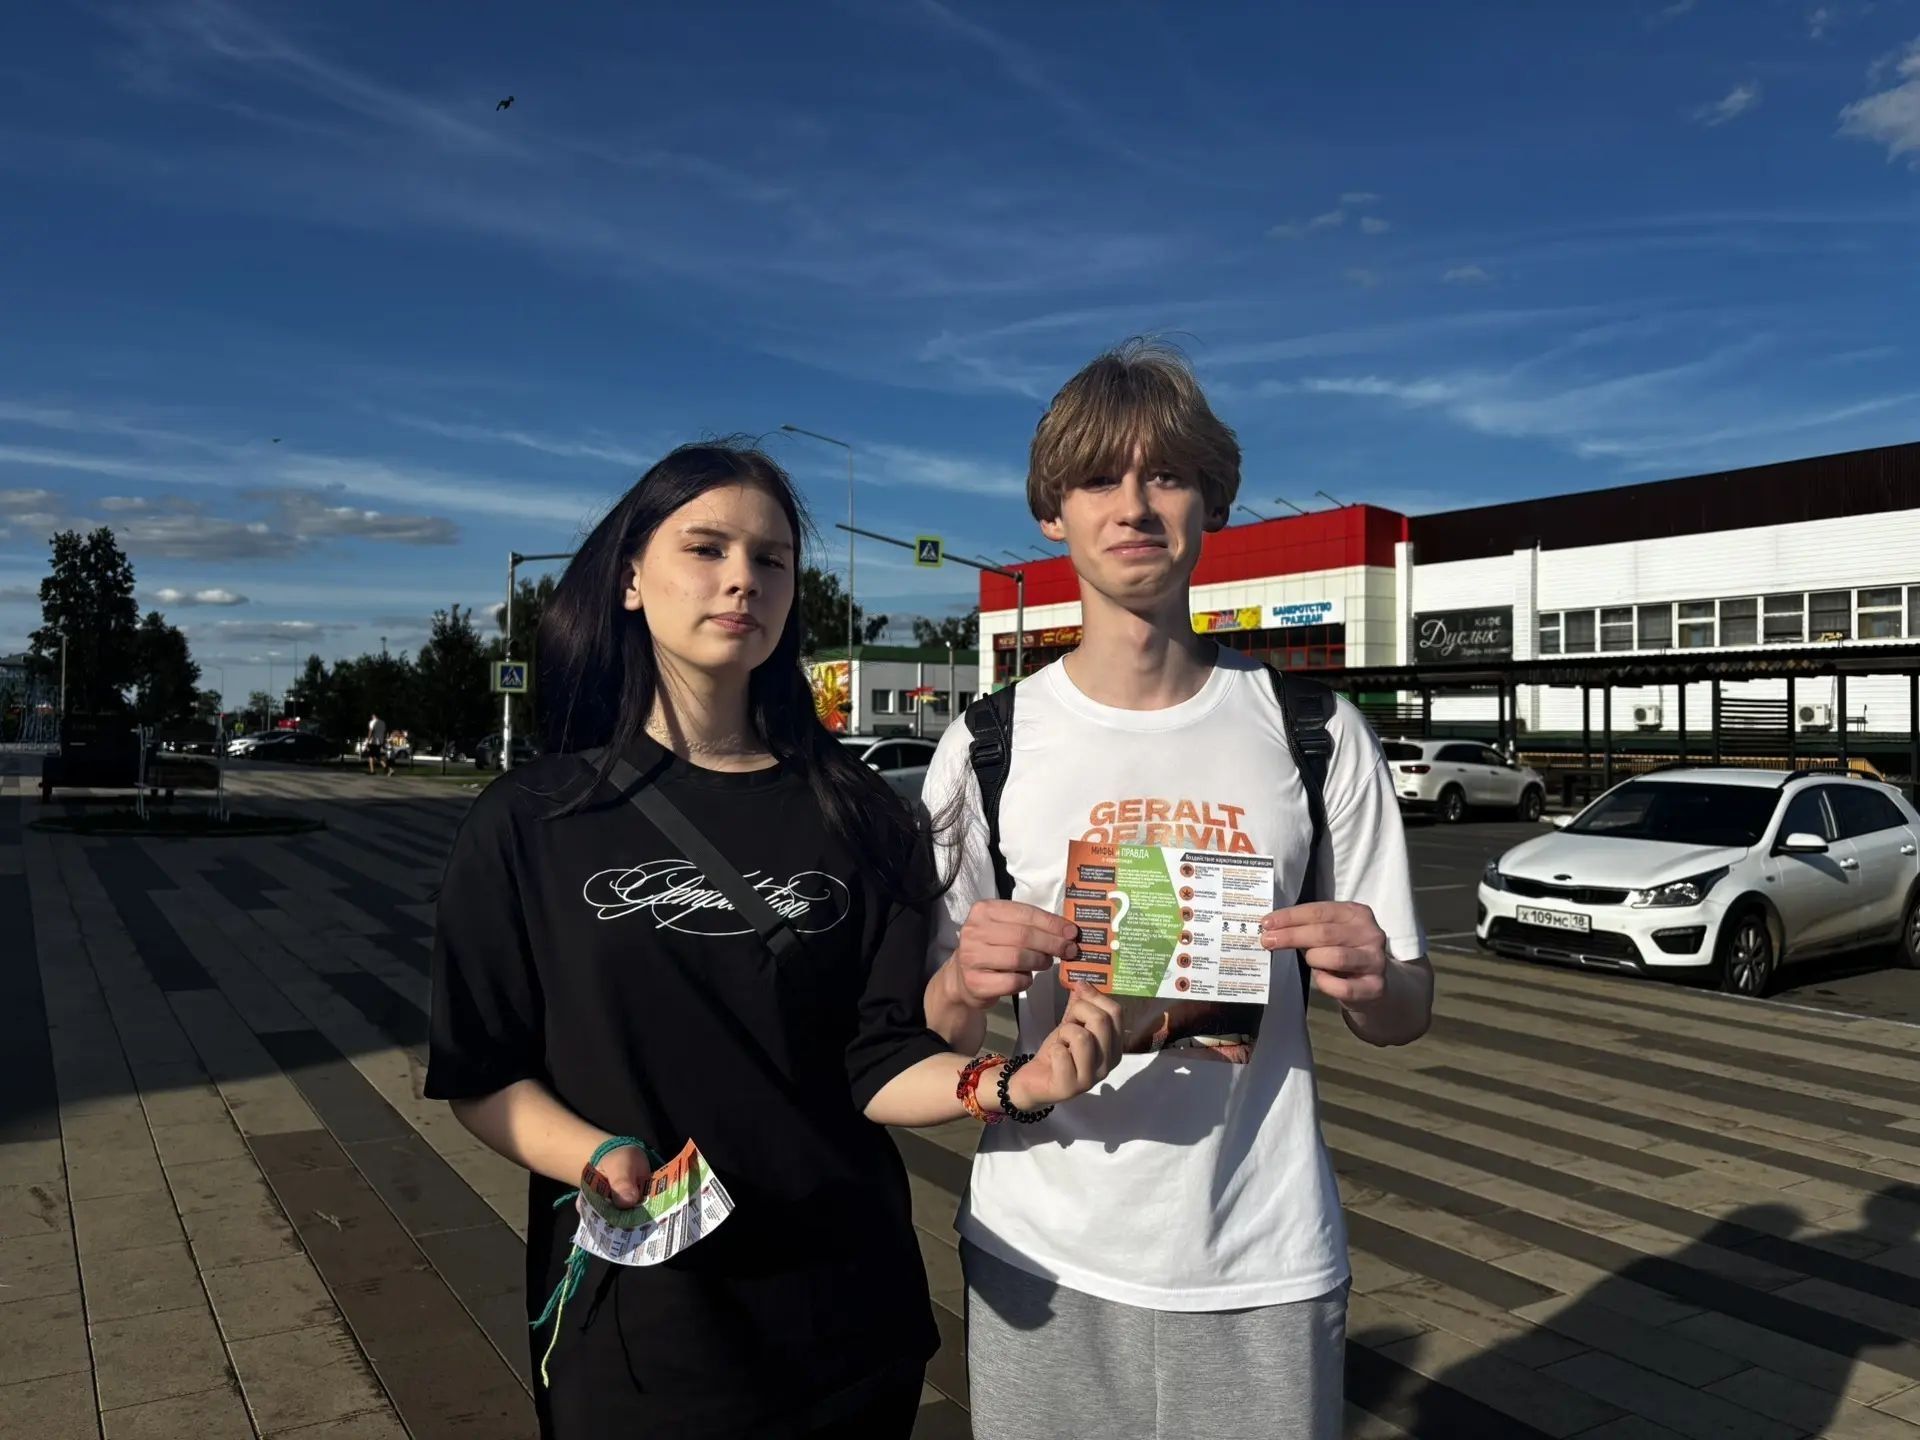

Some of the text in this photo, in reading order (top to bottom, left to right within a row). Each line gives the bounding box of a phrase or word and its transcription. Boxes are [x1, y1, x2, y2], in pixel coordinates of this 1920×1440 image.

[1273, 602, 1332, 616] БАНКРОТСТВО
[1280, 614, 1323, 626] ГРАЖДАН
[1475, 616, 1501, 627] КАФЕ
[1090, 799, 1245, 829] GERALT
[1081, 823, 1256, 854] OF RIVIA
[1091, 846, 1114, 856] МИФЫ
[1121, 848, 1149, 859] ПРАВДА
[1573, 916, 1584, 926] 18
